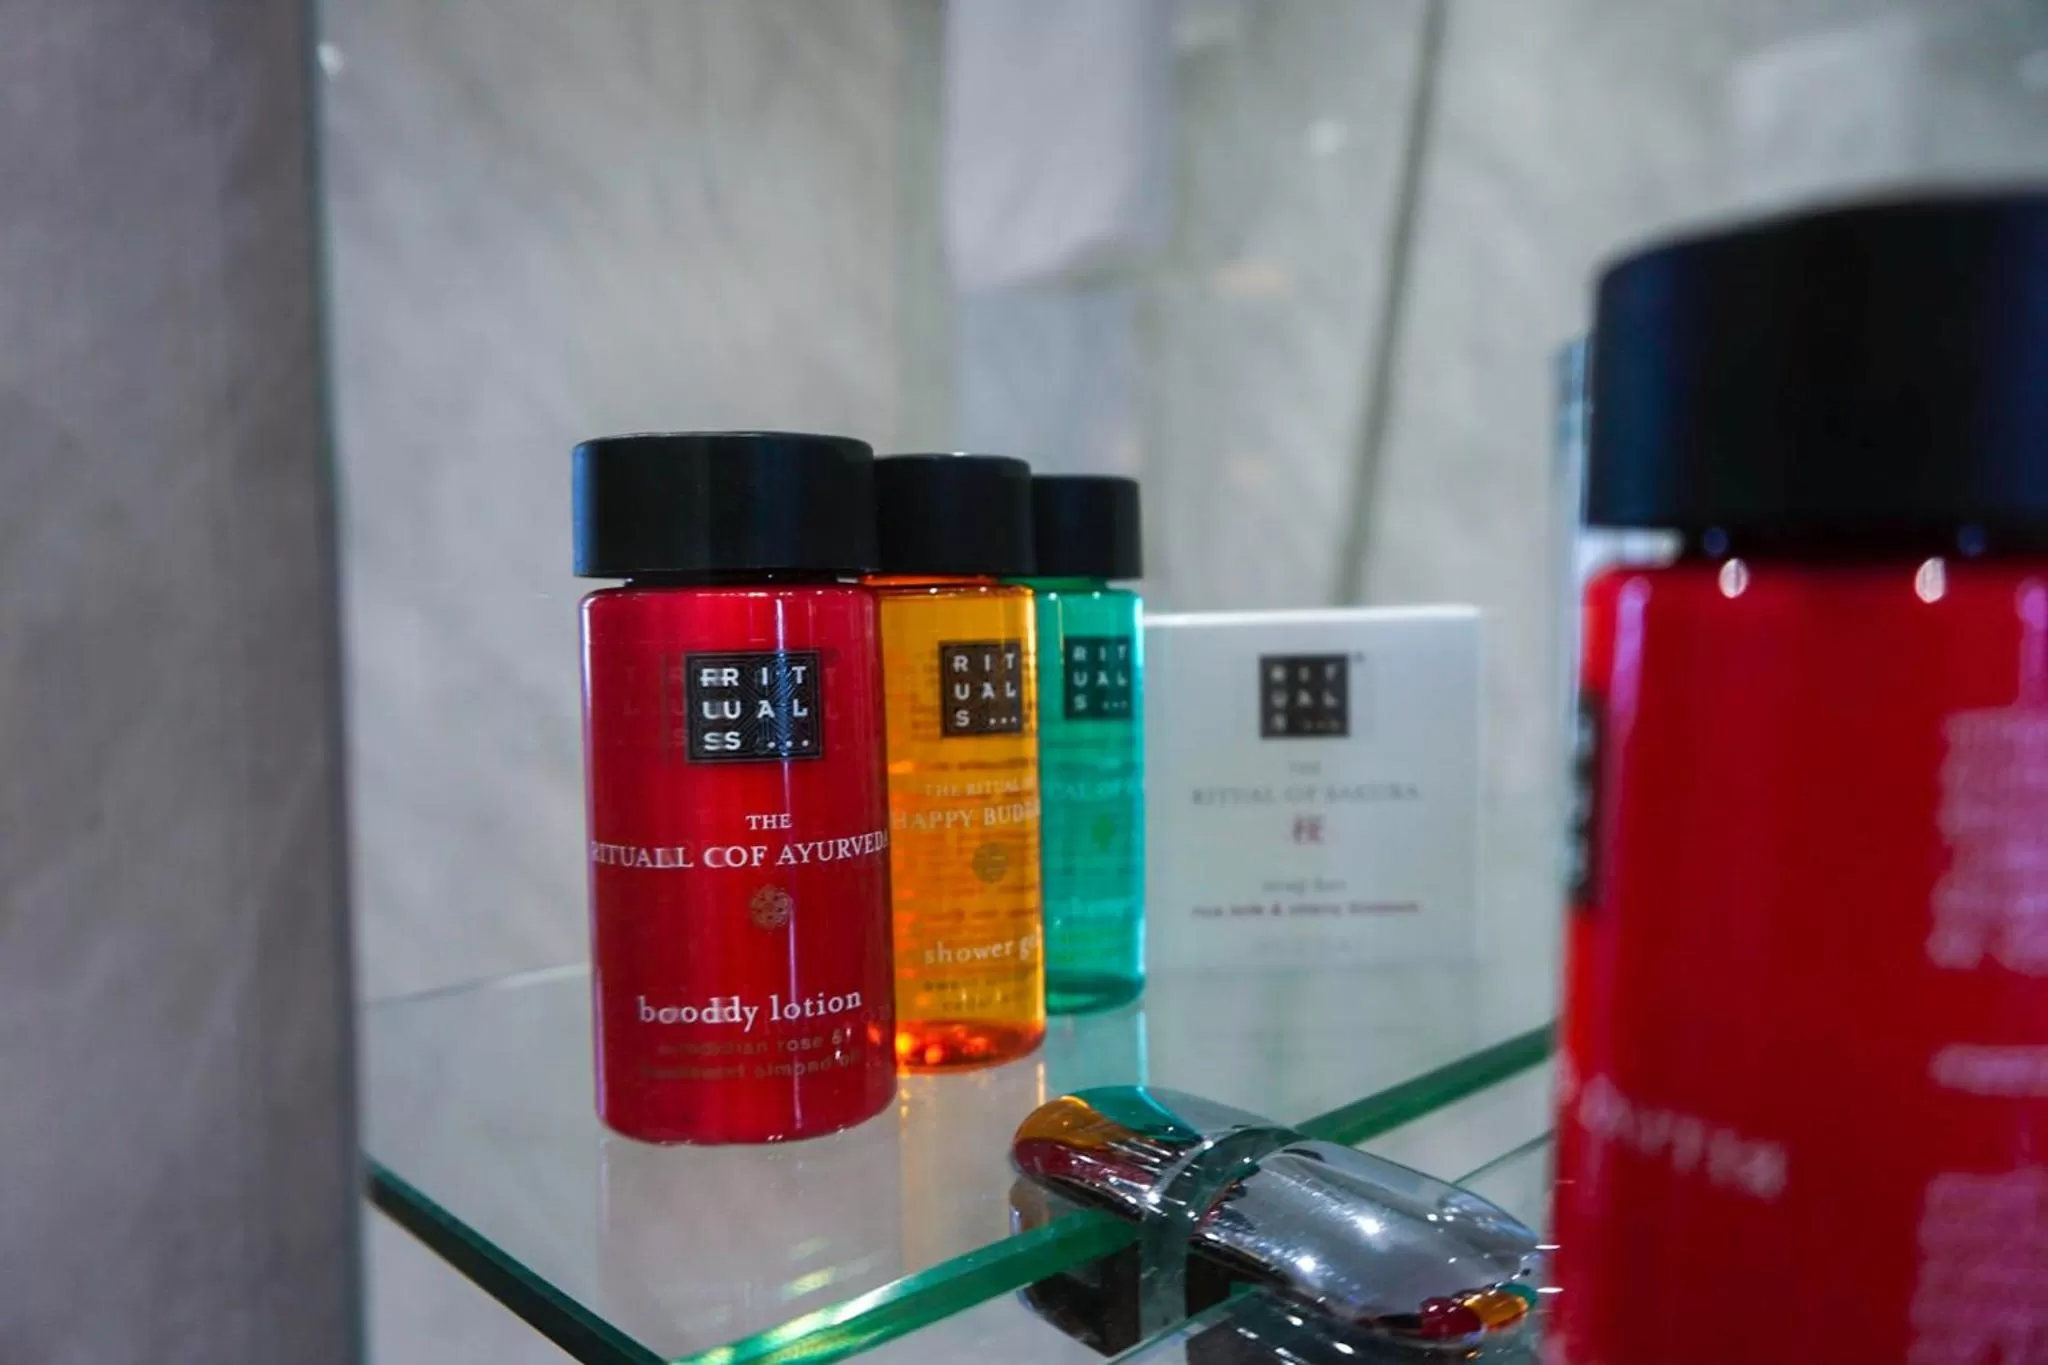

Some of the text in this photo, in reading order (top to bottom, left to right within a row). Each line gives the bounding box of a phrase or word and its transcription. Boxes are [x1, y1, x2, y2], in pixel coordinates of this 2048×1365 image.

[745, 813, 793, 831] THE
[924, 940, 1013, 965] shower
[769, 991, 863, 1022] lotion
